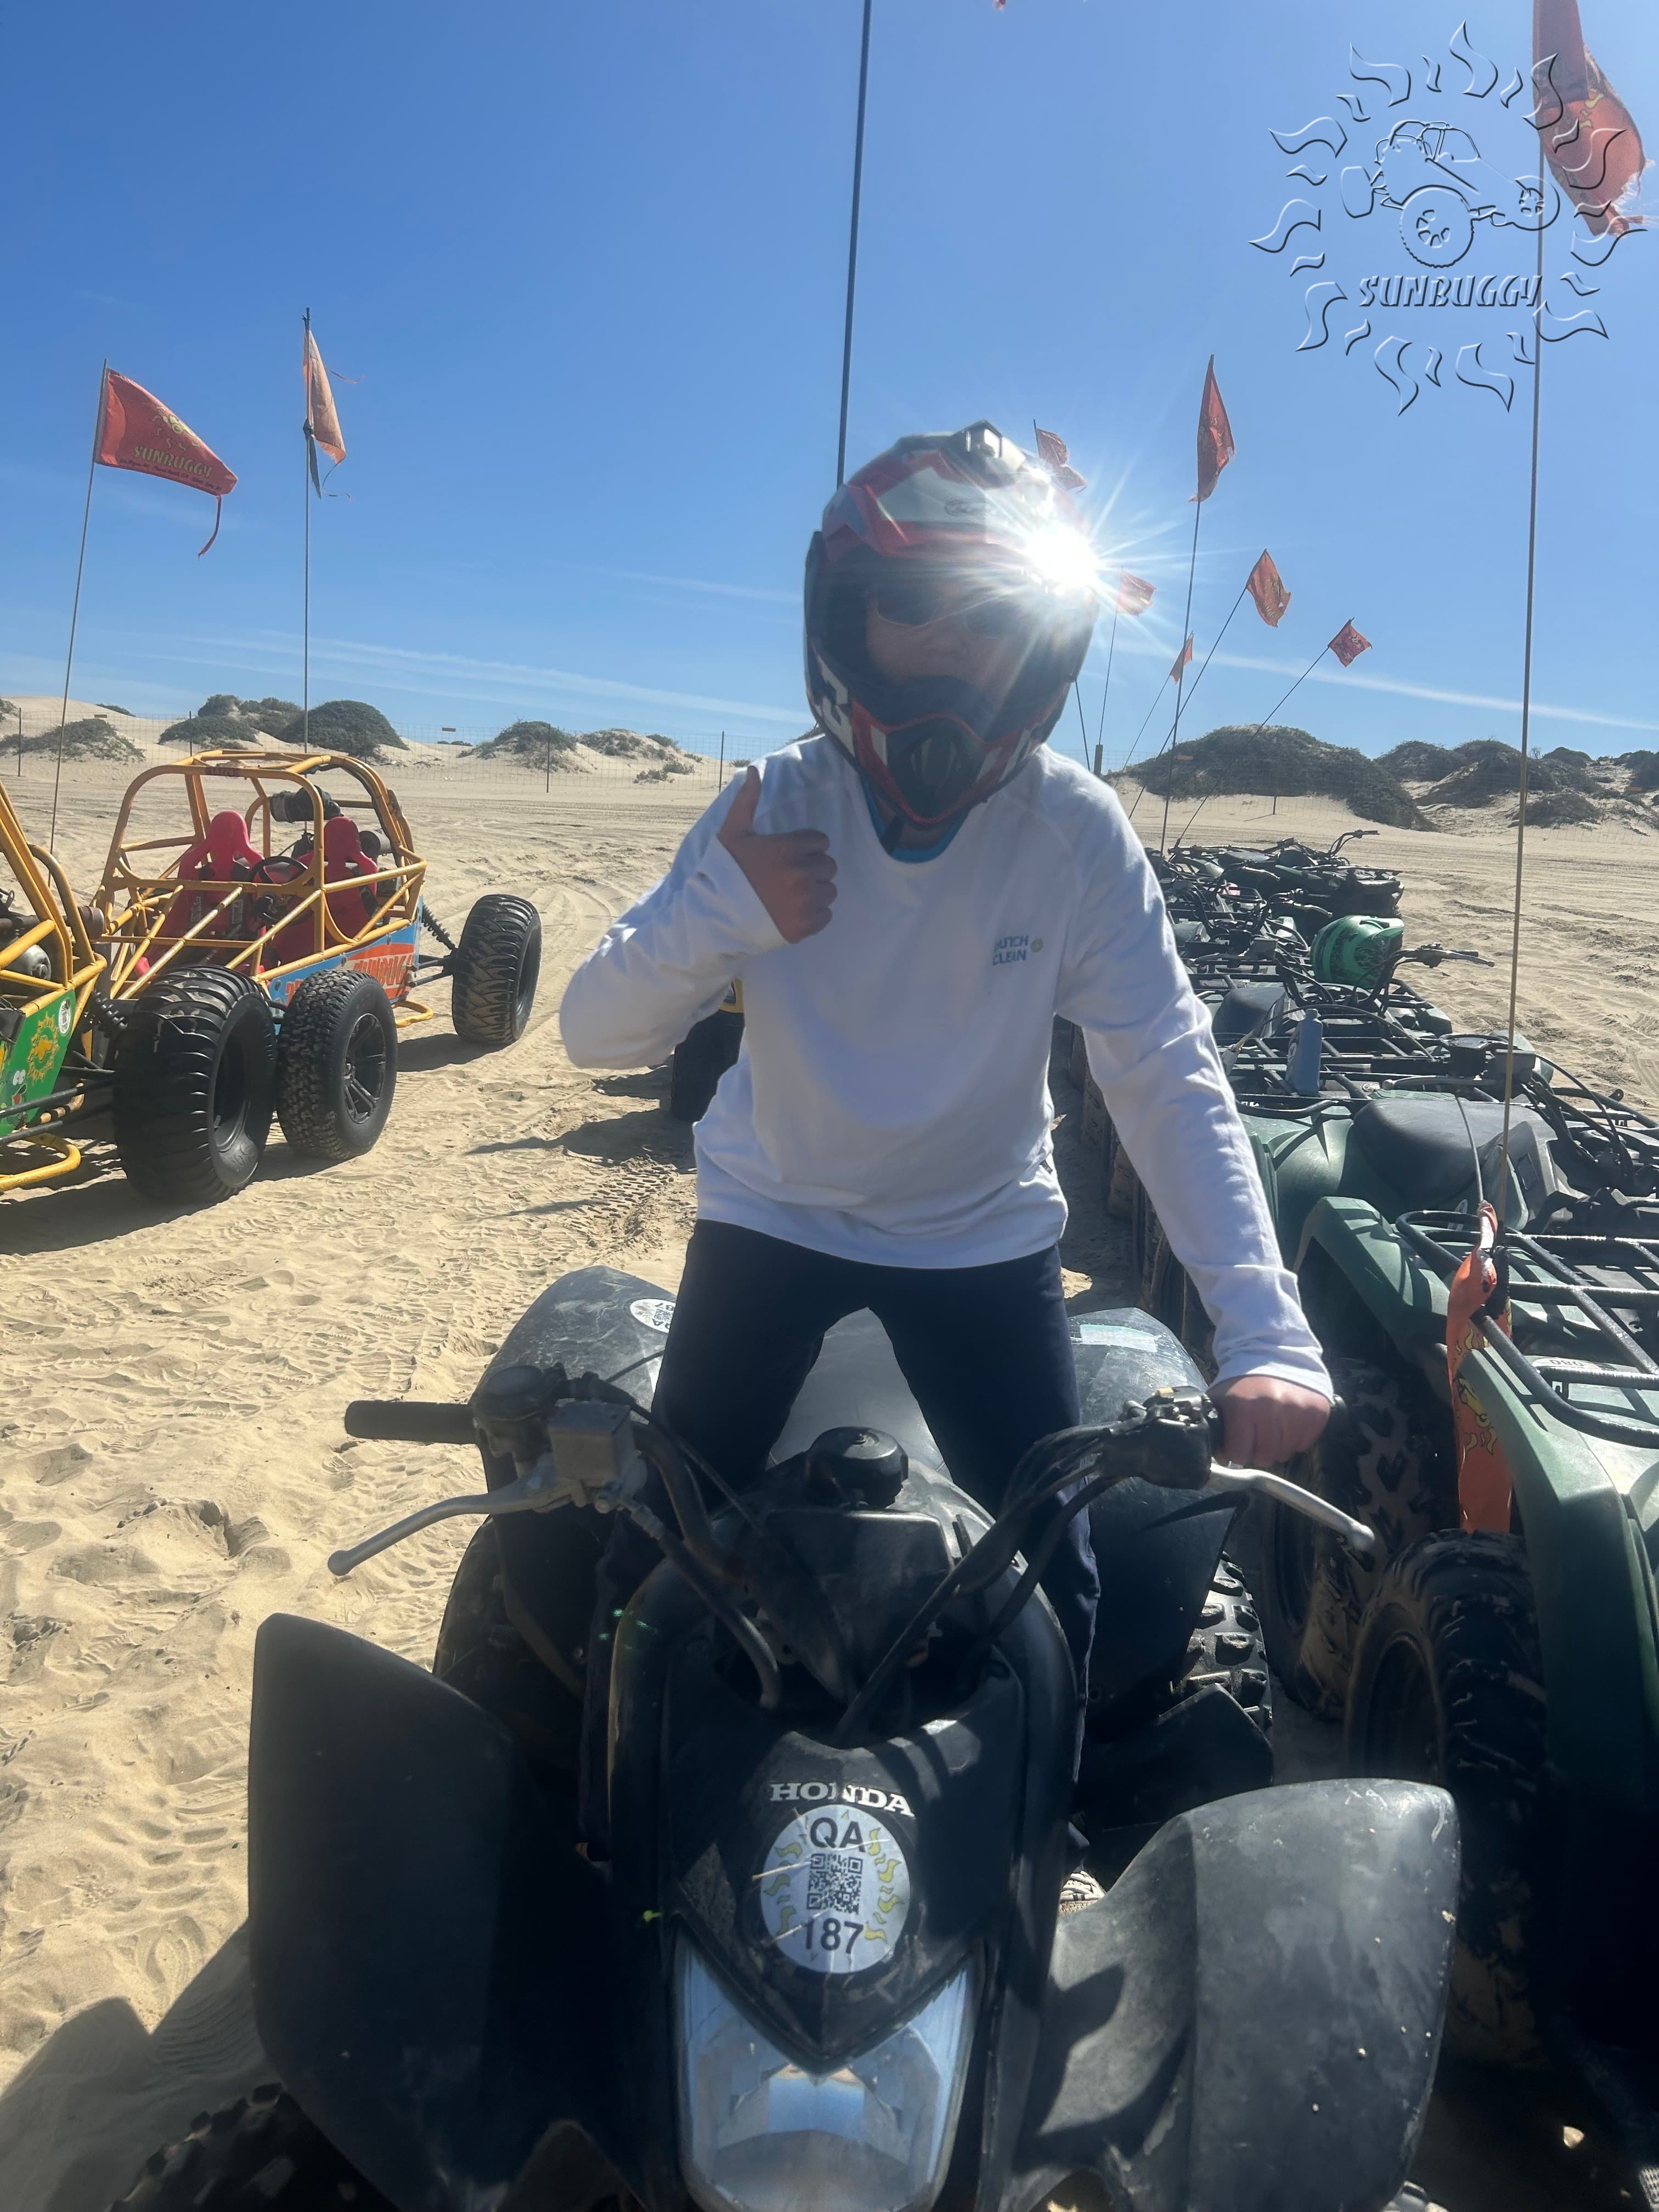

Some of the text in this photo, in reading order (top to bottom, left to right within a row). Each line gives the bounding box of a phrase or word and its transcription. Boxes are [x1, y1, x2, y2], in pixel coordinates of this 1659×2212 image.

[134, 445, 213, 478] SUNBUGGY
[770, 1781, 916, 1819] HONDA
[810, 1817, 866, 1853] QA
[803, 1918, 864, 1954] 187
